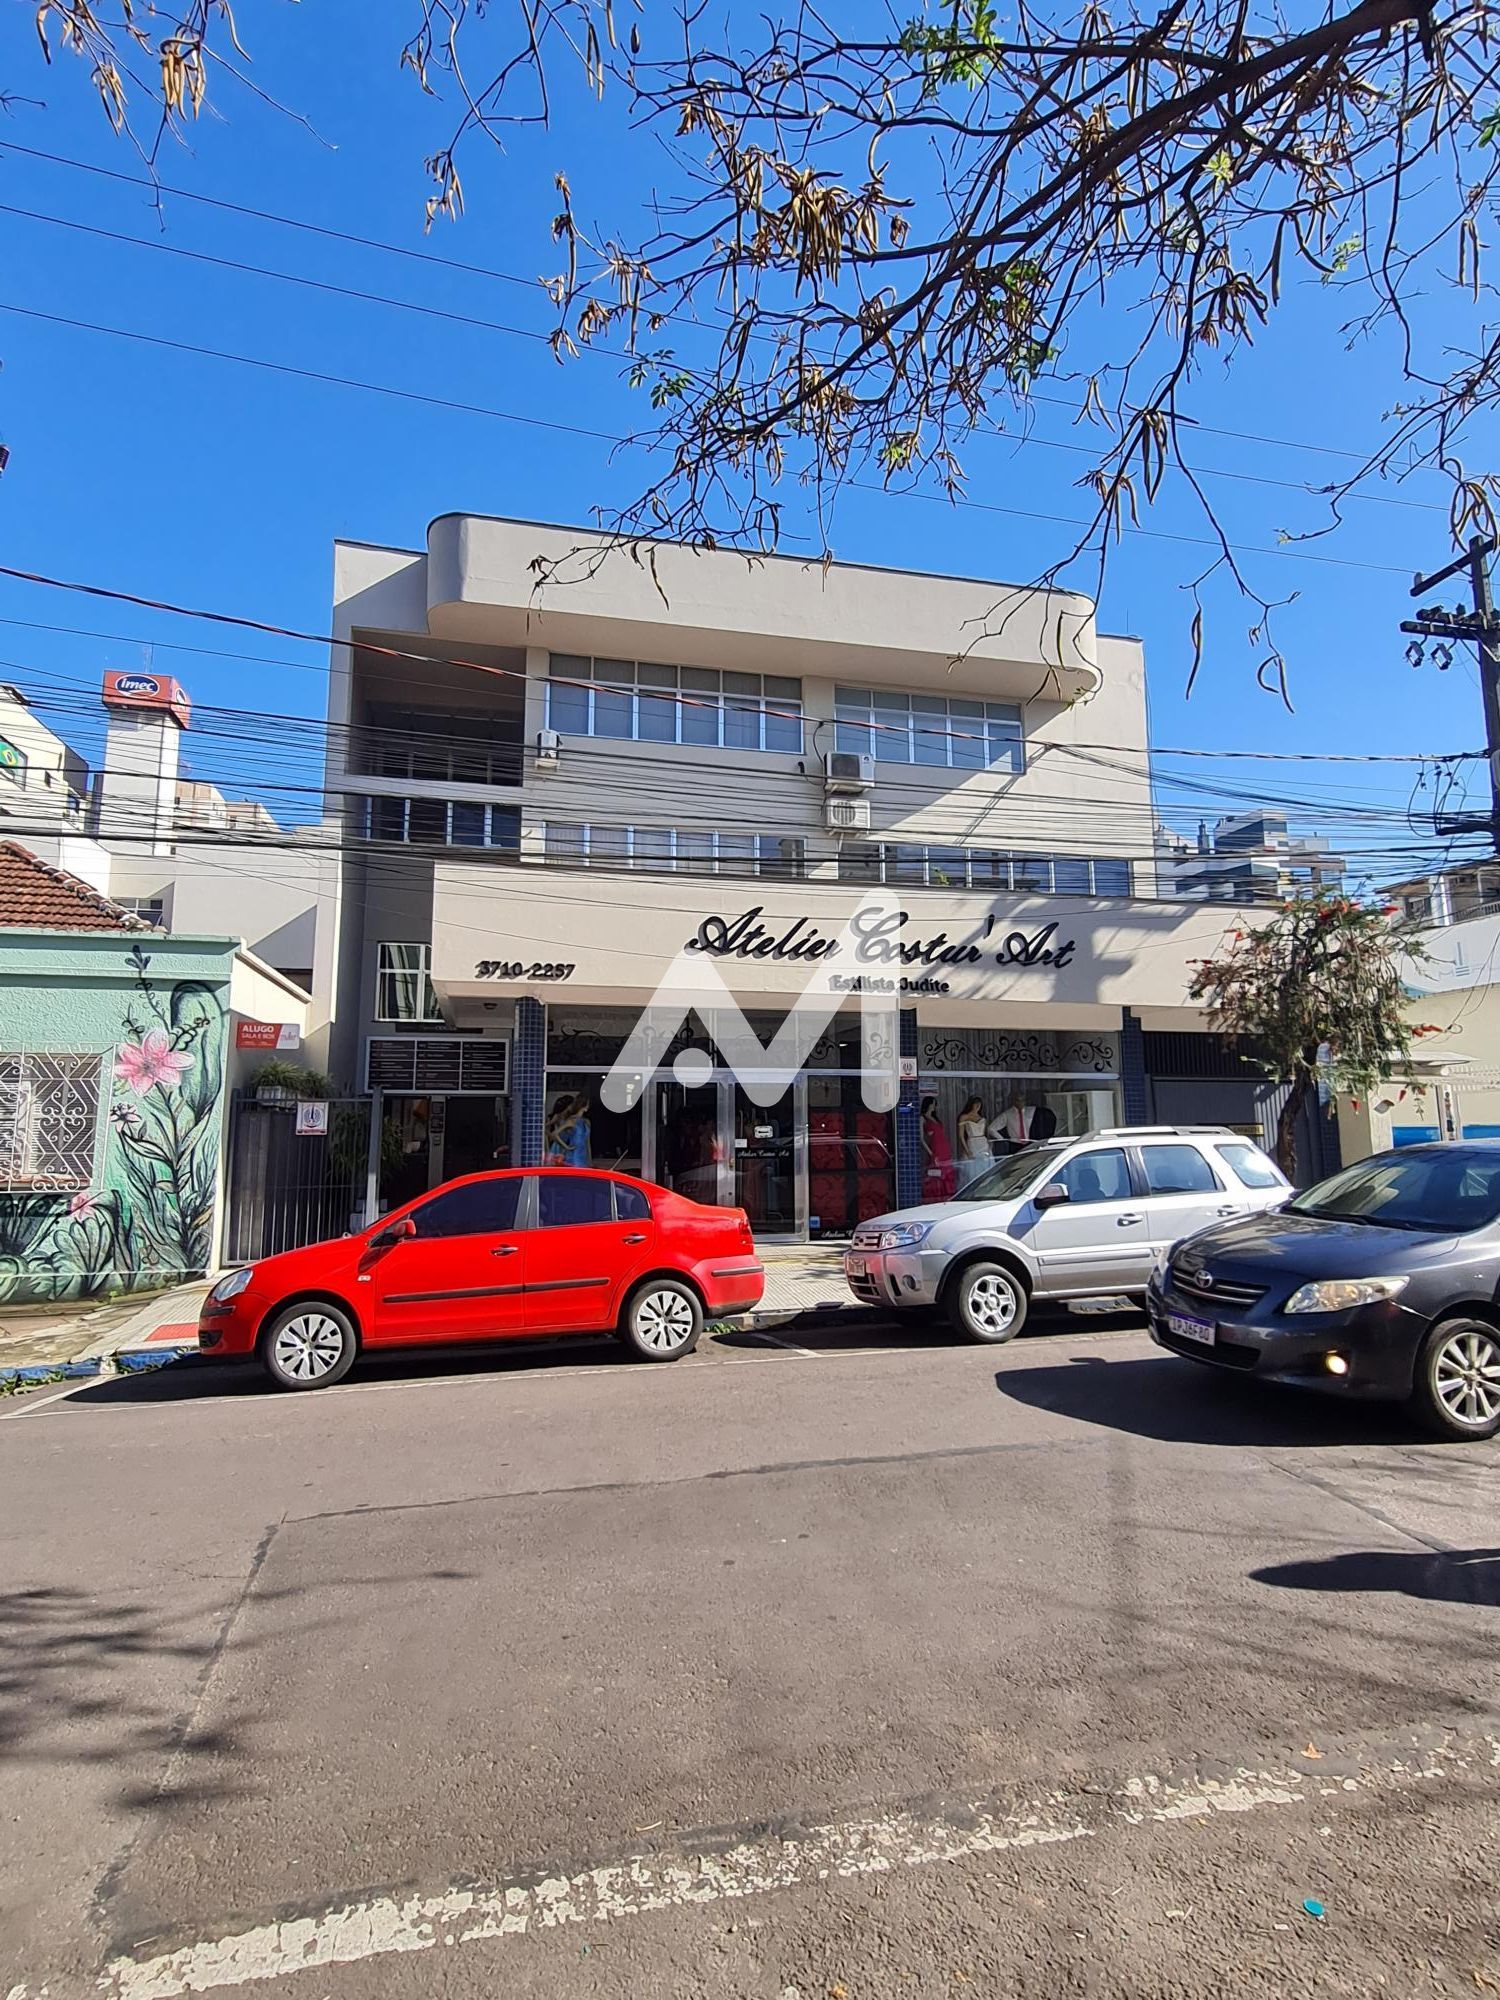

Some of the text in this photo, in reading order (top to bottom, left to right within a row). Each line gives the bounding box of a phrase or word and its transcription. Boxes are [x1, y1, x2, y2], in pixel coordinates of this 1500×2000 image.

[121, 678, 155, 691] imec
[686, 906, 841, 960] Atelier
[996, 922, 1076, 968] Art
[475, 960, 576, 981] 3710-2257
[830, 974, 950, 993] Estilista Judite
[242, 1025, 274, 1033] ALUGO
